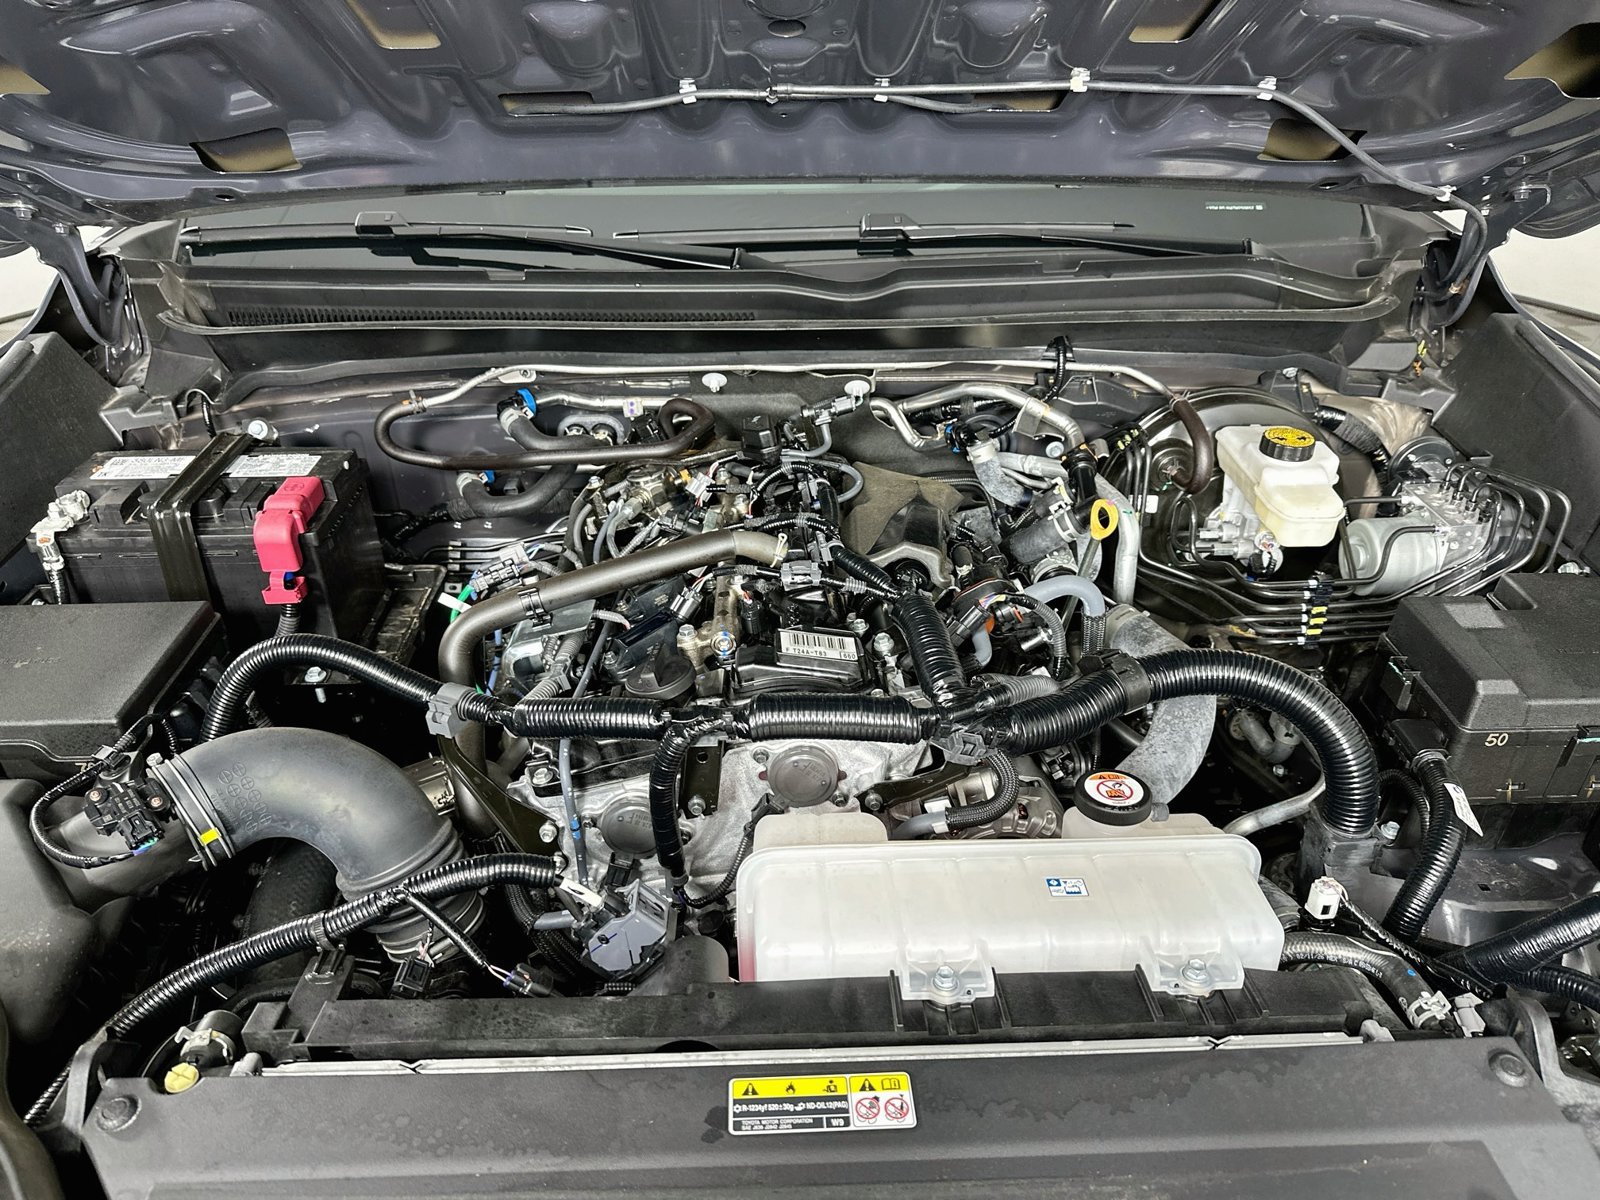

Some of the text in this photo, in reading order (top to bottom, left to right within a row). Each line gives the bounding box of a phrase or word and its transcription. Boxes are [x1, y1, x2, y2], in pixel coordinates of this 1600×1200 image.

[1484, 733, 1509, 747] 50
[742, 1103, 767, 1112] R-1234yf
[830, 1118, 845, 1127] W9
